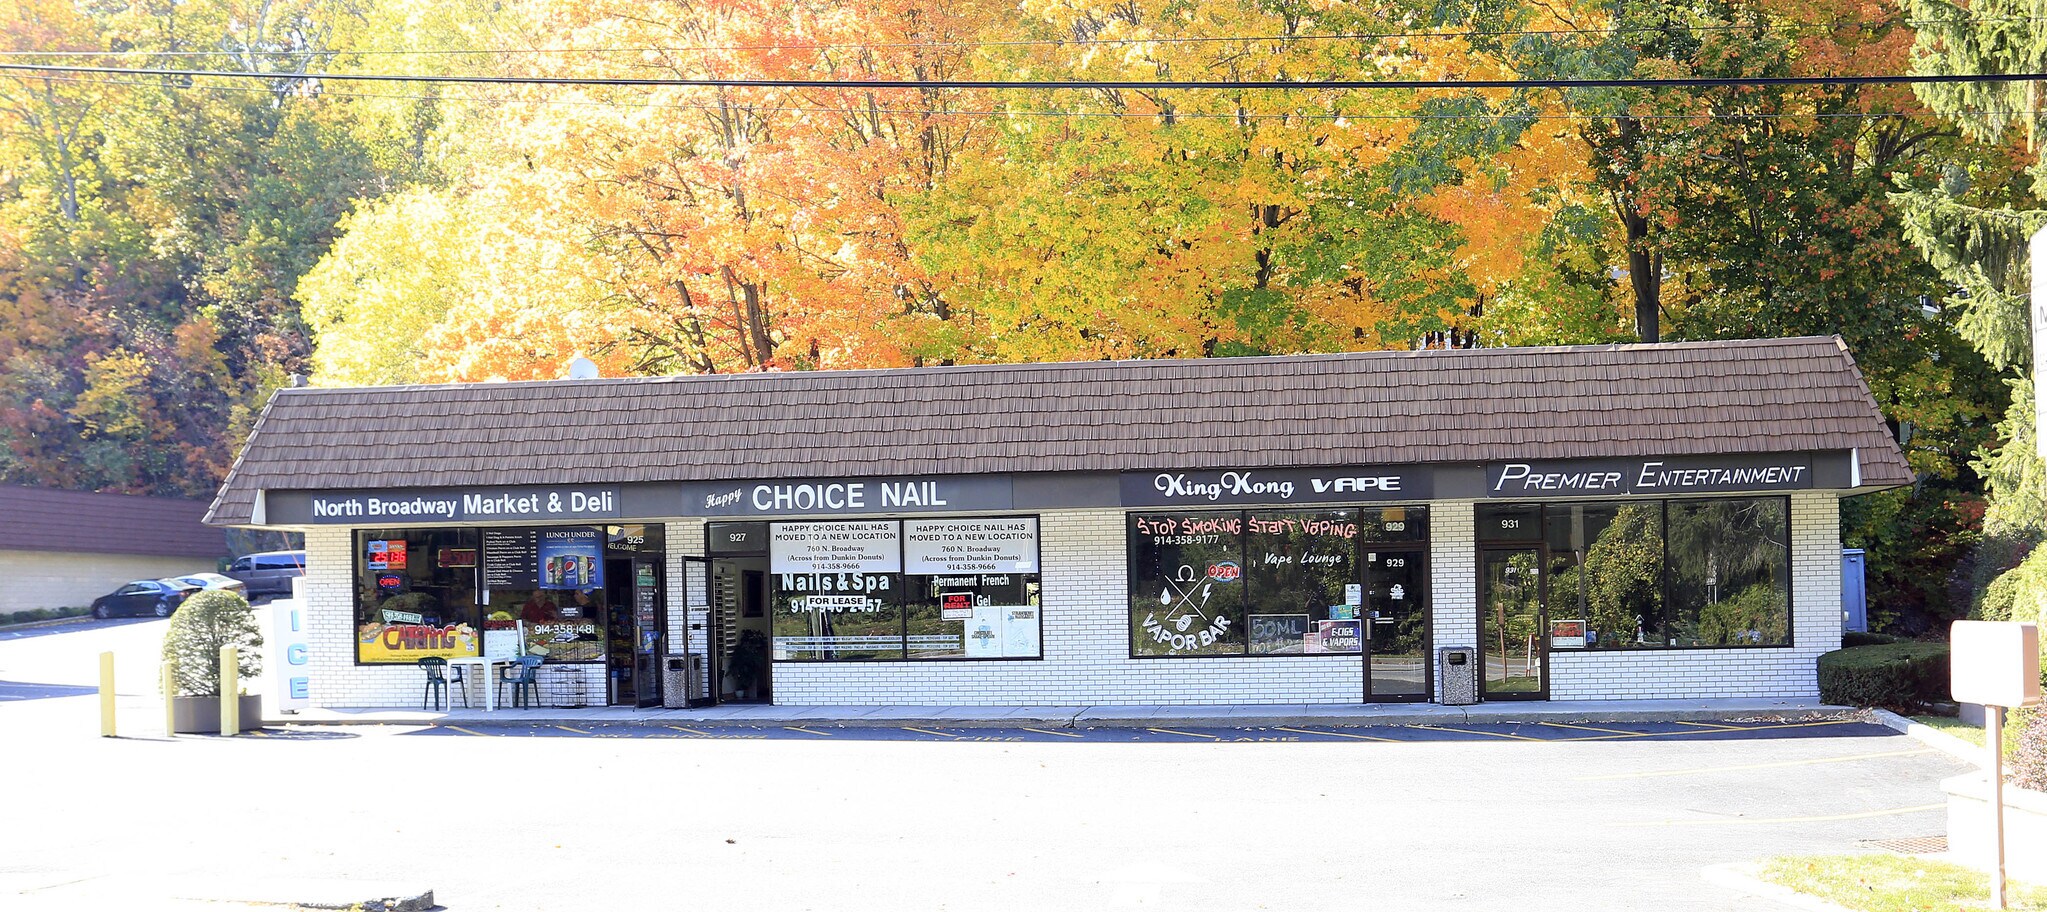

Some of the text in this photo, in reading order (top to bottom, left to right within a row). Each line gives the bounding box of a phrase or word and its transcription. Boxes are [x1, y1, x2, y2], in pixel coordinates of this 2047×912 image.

[1493, 461, 1806, 491] PREMIER ENTERTAINMENT
[1310, 476, 1401, 493] VAPE
[705, 481, 947, 510] Happy CHOICE NAIL
[313, 491, 613, 518] North Broadway Market & Deli
[813, 524, 845, 532] CHOICE
[947, 524, 981, 532] CHOICE
[1007, 523, 1026, 531] HAS
[1137, 517, 1177, 535] STOP
[1385, 522, 1405, 531] 929
[1501, 519, 1520, 529] 931
[627, 535, 644, 544] 925
[729, 533, 746, 542] 927
[852, 532, 896, 540] LOCATION
[988, 532, 1033, 540] LOCATION
[1154, 534, 1219, 545] 914-358-9177
[831, 545, 865, 553] Broadway
[967, 545, 1001, 553] Broadway
[787, 554, 812, 562] (Across
[858, 553, 885, 561] Donuts)
[922, 554, 947, 562] (Across
[994, 553, 1021, 561] Donuts)
[1264, 551, 1342, 569] Vape Lounge
[946, 563, 996, 571] 914-358-9666
[1386, 558, 1405, 567] 929
[1207, 564, 1241, 578] OPEN
[379, 578, 400, 587] OPEN
[933, 574, 1010, 587] Permanent French
[809, 597, 830, 605] FOR
[948, 595, 966, 603] FOR
[976, 594, 991, 606] Gel
[1142, 612, 1198, 650] VAPOR
[1199, 615, 1231, 647] BAR
[1322, 637, 1328, 647] &
[1329, 637, 1359, 647] VAPORS
[287, 608, 309, 699] ICE
